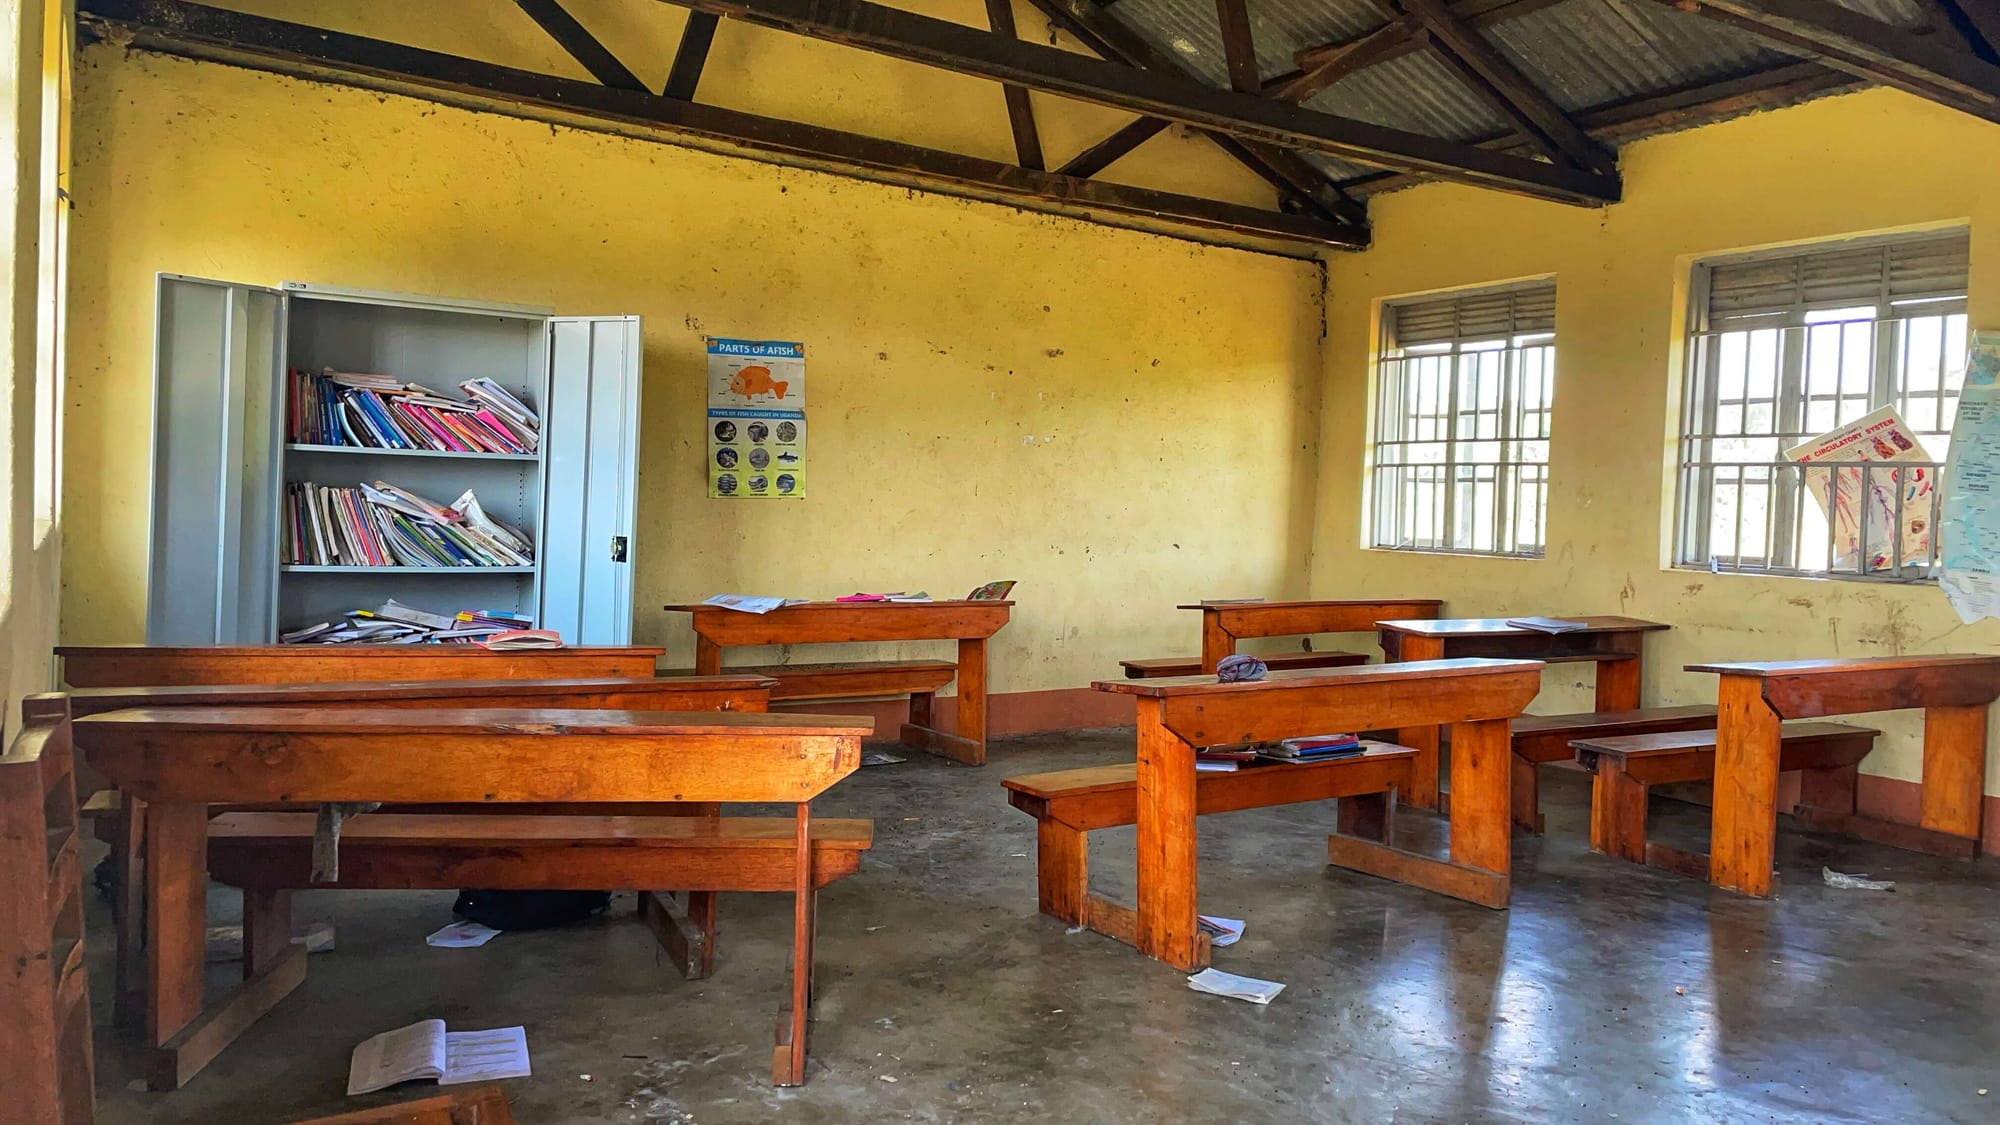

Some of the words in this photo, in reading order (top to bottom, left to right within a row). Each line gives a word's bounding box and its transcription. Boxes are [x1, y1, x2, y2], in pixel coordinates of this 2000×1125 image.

[719, 343, 750, 354] PARTS
[752, 345, 765, 354] OF
[1814, 432, 1862, 457] CIRCULATORY
[1865, 418, 1895, 434] SYSTEM
